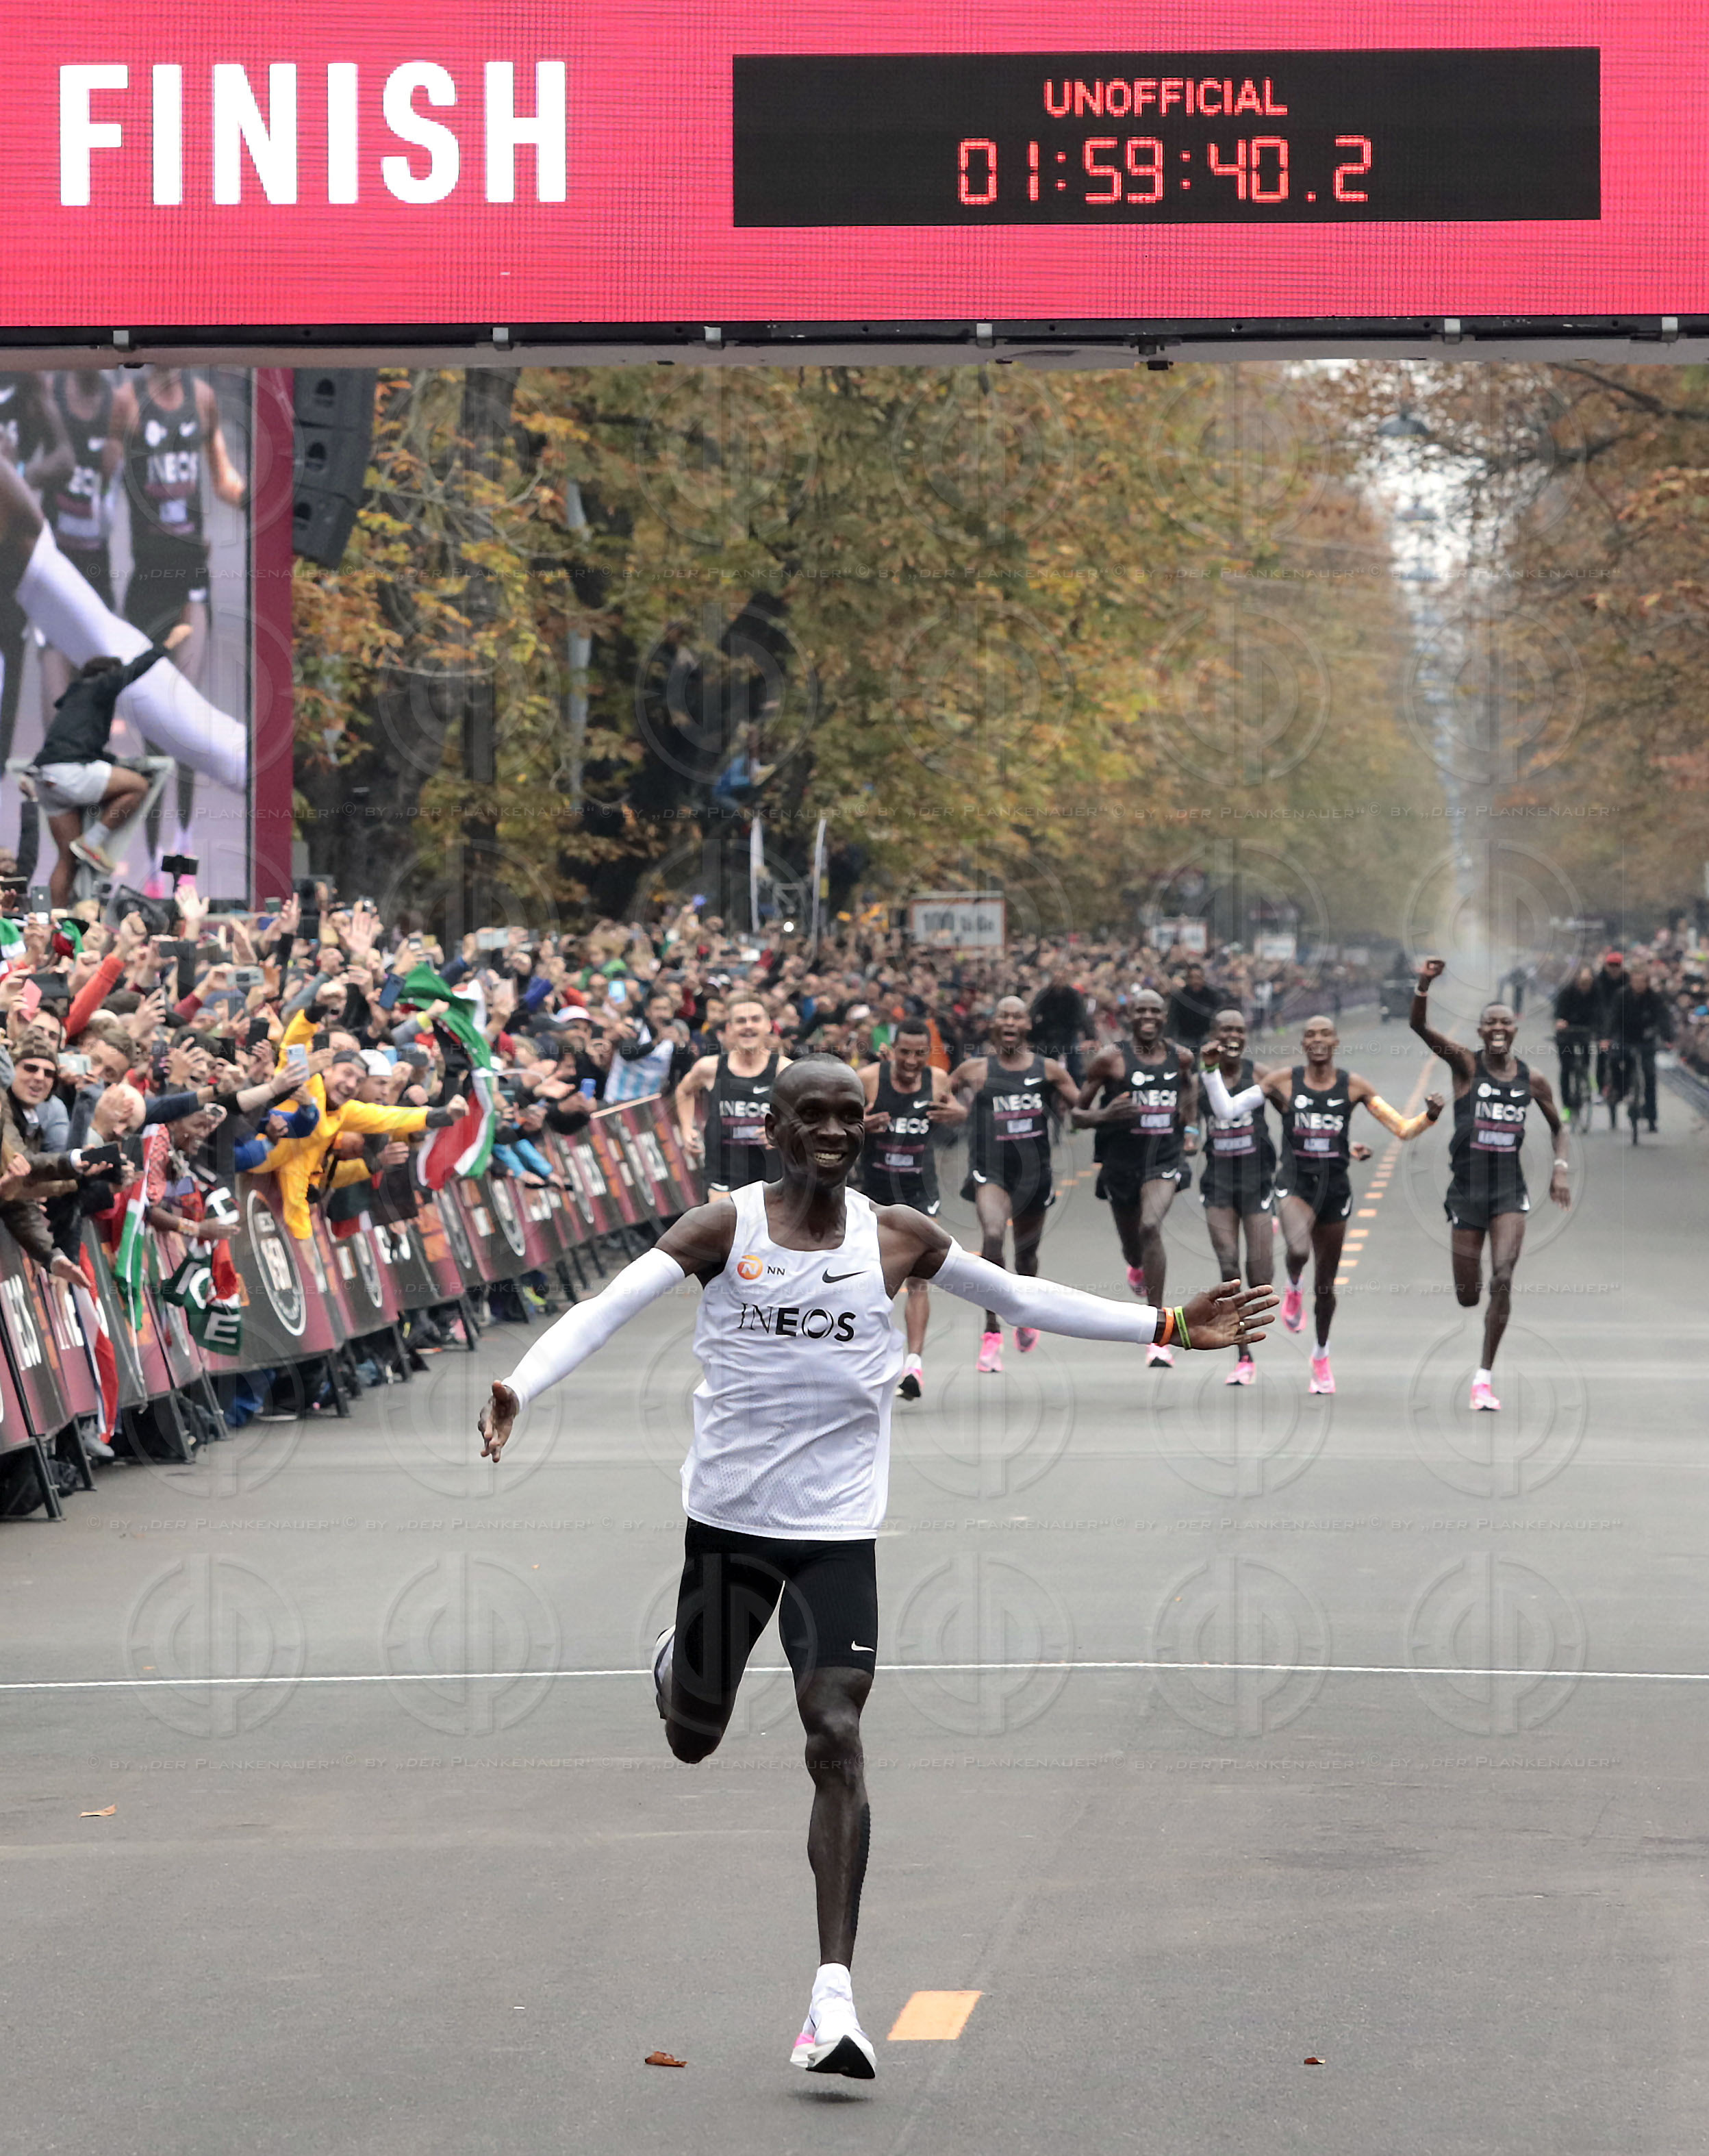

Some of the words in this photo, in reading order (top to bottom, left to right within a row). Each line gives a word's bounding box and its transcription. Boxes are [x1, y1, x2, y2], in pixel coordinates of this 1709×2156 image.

[1043, 76, 1289, 118] UNOFFICIAL
[60, 61, 566, 206] FINISH
[992, 1092, 1043, 1113] INEOS
[1132, 1089, 1177, 1107] INEOS
[1294, 1112, 1344, 1131] INEOS
[1474, 1100, 1526, 1123] INEOS
[887, 1117, 930, 1134] NEOS
[767, 1266, 785, 1276] NN
[737, 1303, 857, 1342] INEOS
